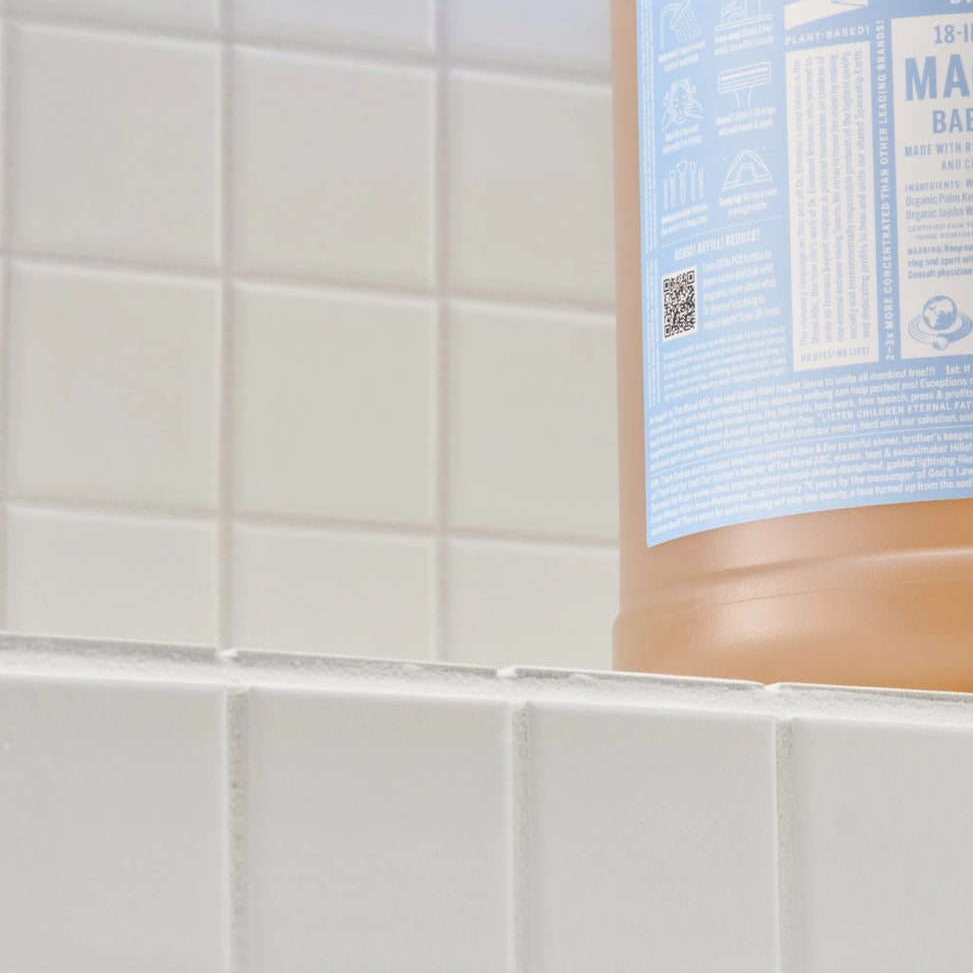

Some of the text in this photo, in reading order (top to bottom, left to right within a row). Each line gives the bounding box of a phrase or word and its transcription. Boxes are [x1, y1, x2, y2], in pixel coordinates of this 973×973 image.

[875, 20, 886, 70] BRANDS!
[877, 74, 888, 124] LEADING
[878, 127, 889, 165] OTHER
[904, 145, 932, 157] MADE
[936, 143, 961, 155] WITH
[941, 160, 961, 171] AND
[879, 168, 891, 199] THAN
[906, 196, 937, 207] Organic
[940, 193, 960, 203] Palm
[906, 210, 937, 221] Organic
[881, 203, 893, 293] CONCENTRATED
[883, 297, 894, 329] MORE
[857, 406, 904, 418] CHILDREN
[908, 403, 950, 414] ETERNAL
